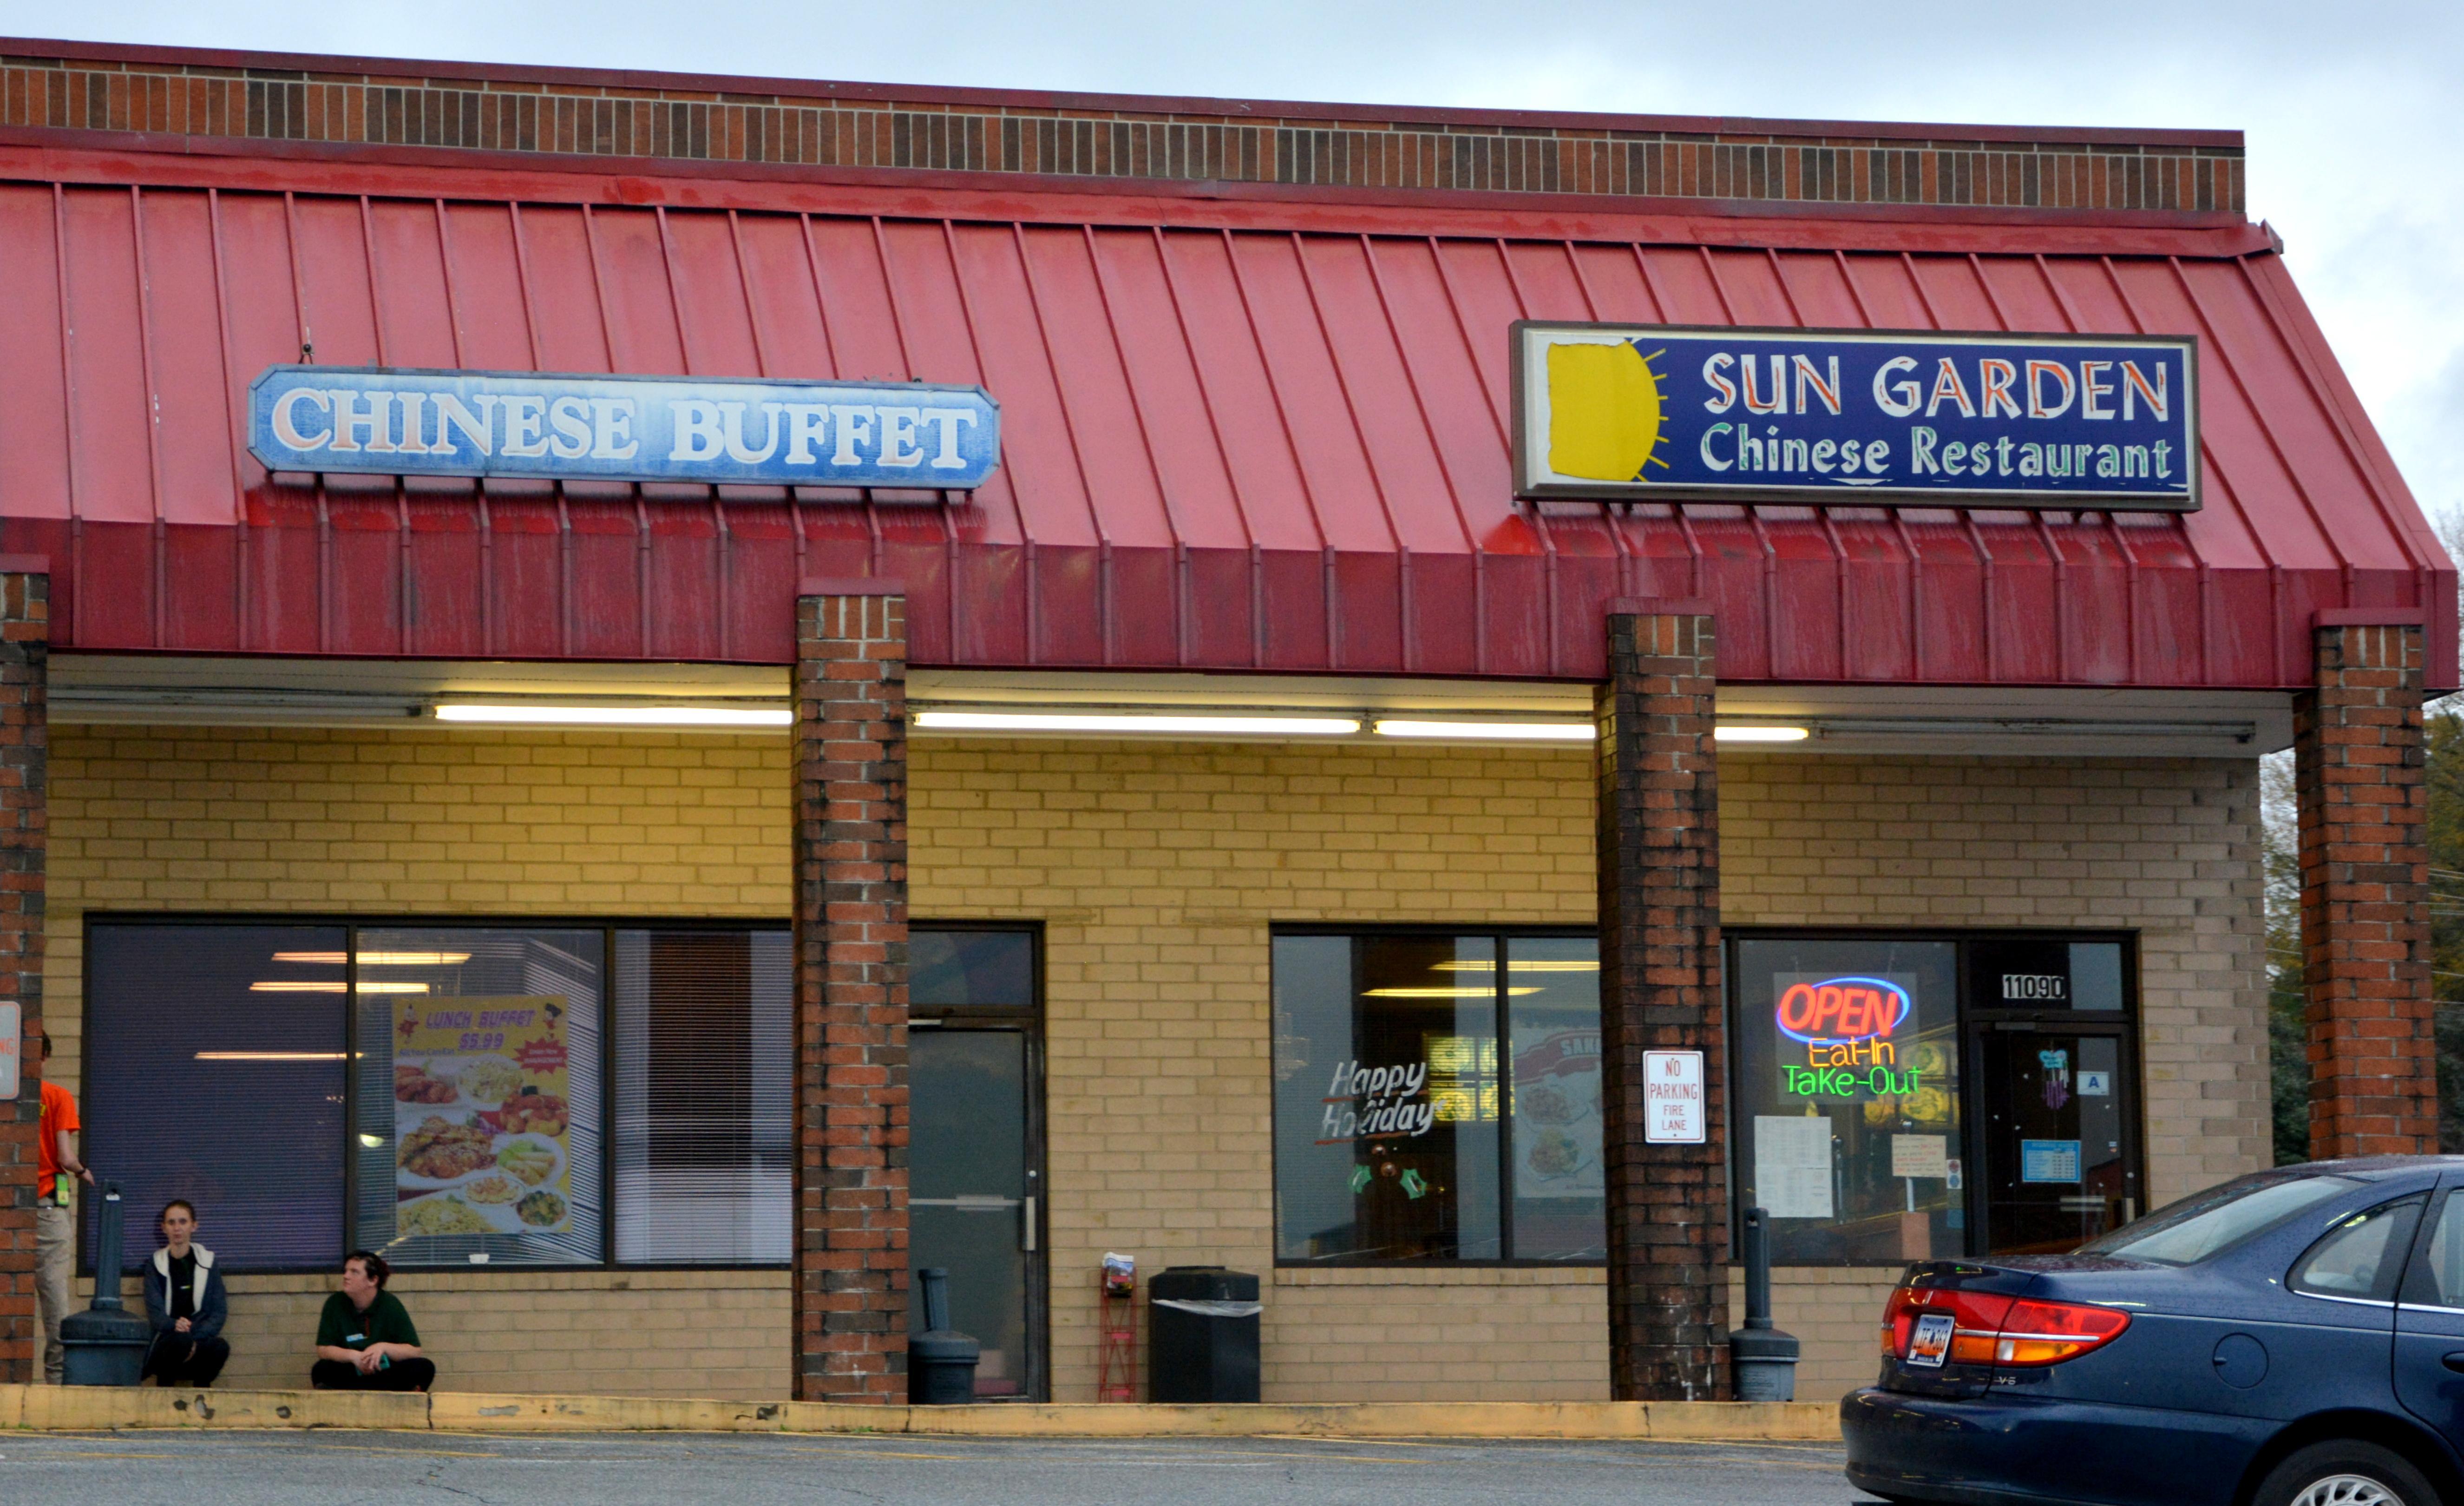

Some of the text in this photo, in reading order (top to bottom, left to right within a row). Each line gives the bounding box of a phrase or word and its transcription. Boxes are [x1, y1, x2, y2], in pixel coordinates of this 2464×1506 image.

[1703, 353, 2169, 422] SUN GARDEN
[271, 387, 976, 468] CHINESE BUFFET
[1700, 422, 2172, 479] Chinese Restaurant
[2005, 976, 2064, 998] 11090
[426, 1010, 536, 1029] LUNCH BUFFET
[1780, 983, 1899, 1038] OPEN
[1809, 1036, 1895, 1067] Eat-In
[1329, 1060, 1426, 1099] Happy
[1665, 1060, 1681, 1077] NO
[1782, 1066, 1922, 1096] Take-Out
[1650, 1084, 1697, 1100] PARKING
[2089, 1076, 2100, 1088] A
[1663, 1105, 1684, 1116] FIRE
[1662, 1120, 1687, 1131] LANE
